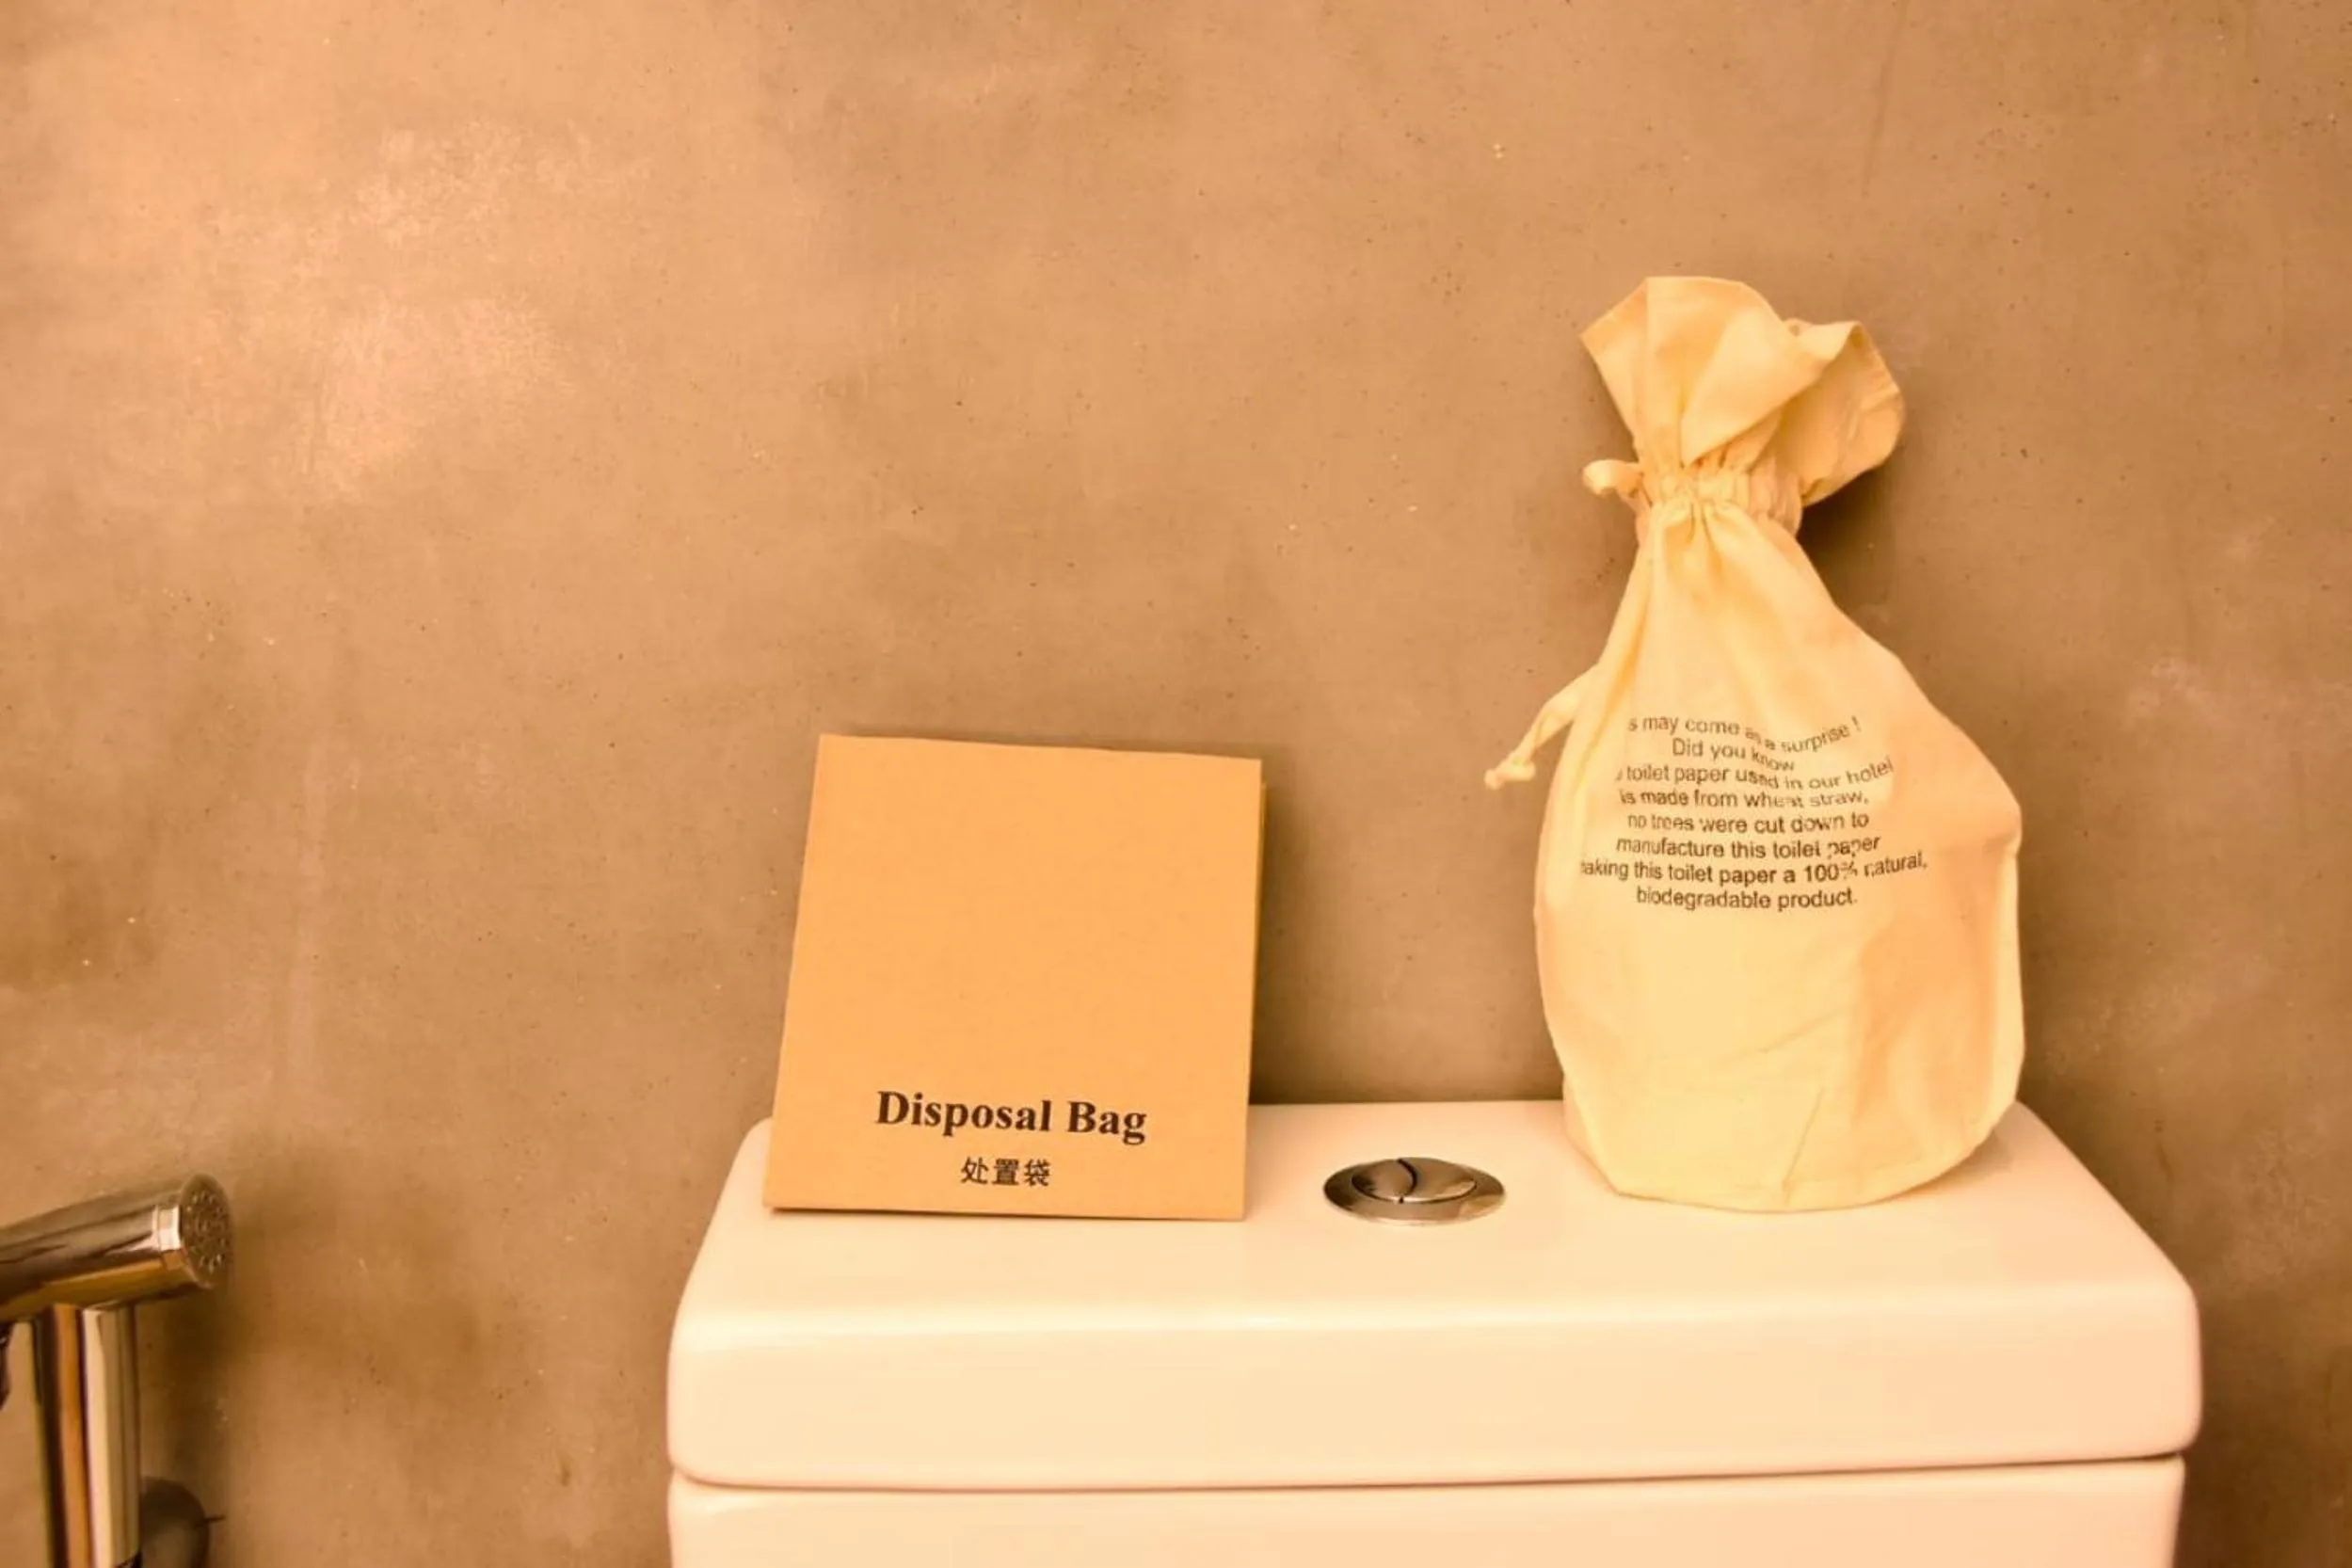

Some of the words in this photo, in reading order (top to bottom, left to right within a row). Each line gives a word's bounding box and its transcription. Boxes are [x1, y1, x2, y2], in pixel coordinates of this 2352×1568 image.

[1642, 716, 1679, 736] may
[1685, 718, 1740, 735] come
[1781, 724, 1850, 753] surprise
[1672, 737, 1704, 757] Did
[1710, 744, 1746, 760] you
[1752, 746, 1795, 772] know
[1626, 764, 1670, 782] toilet
[1674, 766, 1731, 785] paper
[1735, 769, 1779, 790] used
[1784, 775, 1804, 790] in
[1808, 775, 1841, 790] our
[1845, 755, 1895, 784] hotel
[1619, 789, 1636, 805] is
[1640, 790, 1689, 807] made
[1693, 789, 1738, 808] from
[1743, 791, 1804, 808] wheat
[1809, 791, 1870, 808] straw,
[1627, 813, 1647, 829] no
[1651, 813, 1695, 831] trees
[1699, 817, 1748, 834] were
[1753, 816, 1785, 834] cut
[1790, 815, 1845, 833] down
[1851, 811, 1869, 828] to
[1616, 837, 1724, 857] manufacture
[1731, 840, 1767, 858] this
[1772, 840, 1821, 858] toilet
[1827, 836, 1881, 859] paper
[1634, 860, 1663, 879] this
[1669, 863, 1713, 883] toilet
[1720, 868, 1777, 888] paper
[1783, 868, 1796, 883] a
[1636, 885, 1771, 911] biodegradable
[1778, 887, 1859, 912] product.
[875, 1090, 1052, 1137] Disposal
[1067, 1100, 1147, 1145] Bag
[960, 1157, 1052, 1187] 处置袋
